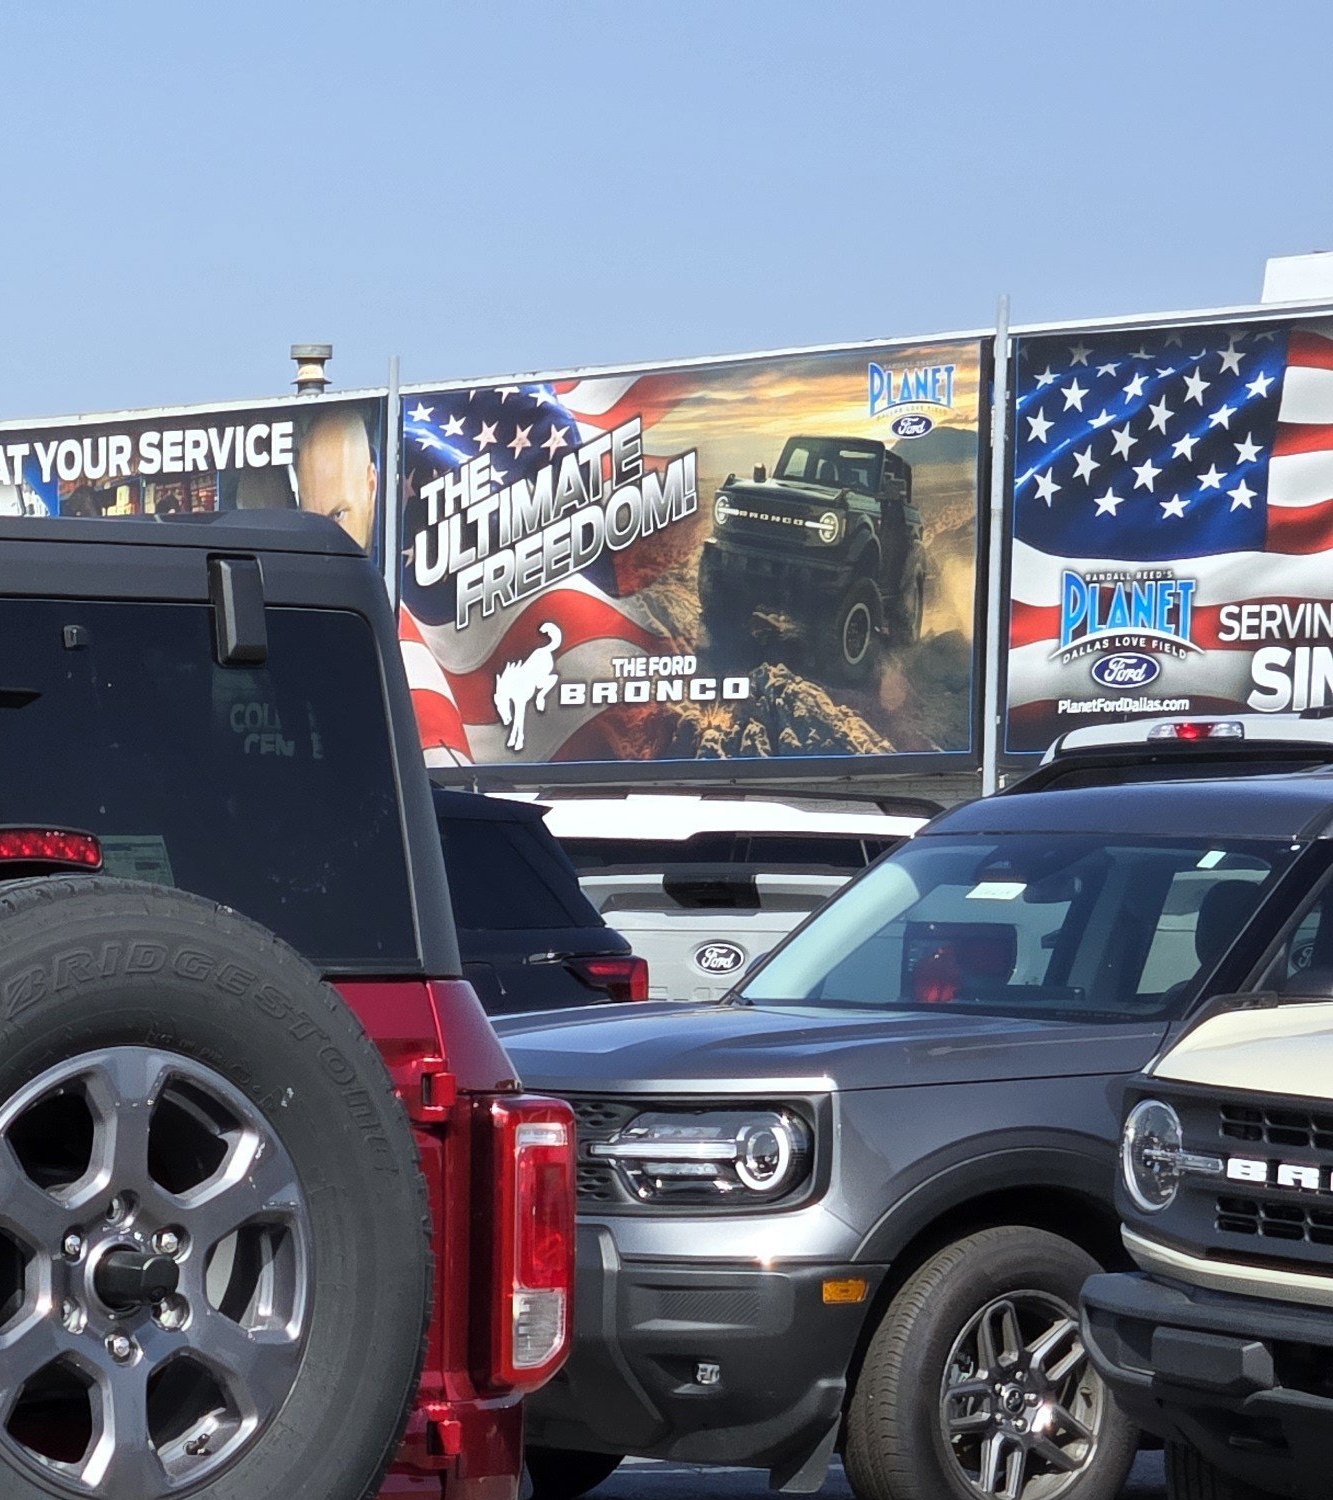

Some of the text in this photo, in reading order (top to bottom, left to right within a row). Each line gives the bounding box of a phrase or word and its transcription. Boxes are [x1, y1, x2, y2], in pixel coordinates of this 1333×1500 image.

[868, 362, 956, 417] PLANET
[898, 416, 926, 435] Ford
[32, 433, 132, 482] YOUR
[139, 420, 294, 474] SERVICE
[413, 415, 644, 588] ULTIMATE
[420, 453, 492, 526] THE
[455, 451, 698, 631] FREEDOM!
[1060, 570, 1197, 650] PLANET
[1063, 636, 1187, 665] DALLAS LOVE FIELD
[612, 656, 697, 679] THE FORD
[1104, 657, 1148, 682] Ford
[560, 677, 750, 706] BRONCO
[1058, 697, 1190, 714] PlanetFordDallas.com
[701, 947, 735, 968] Ford
